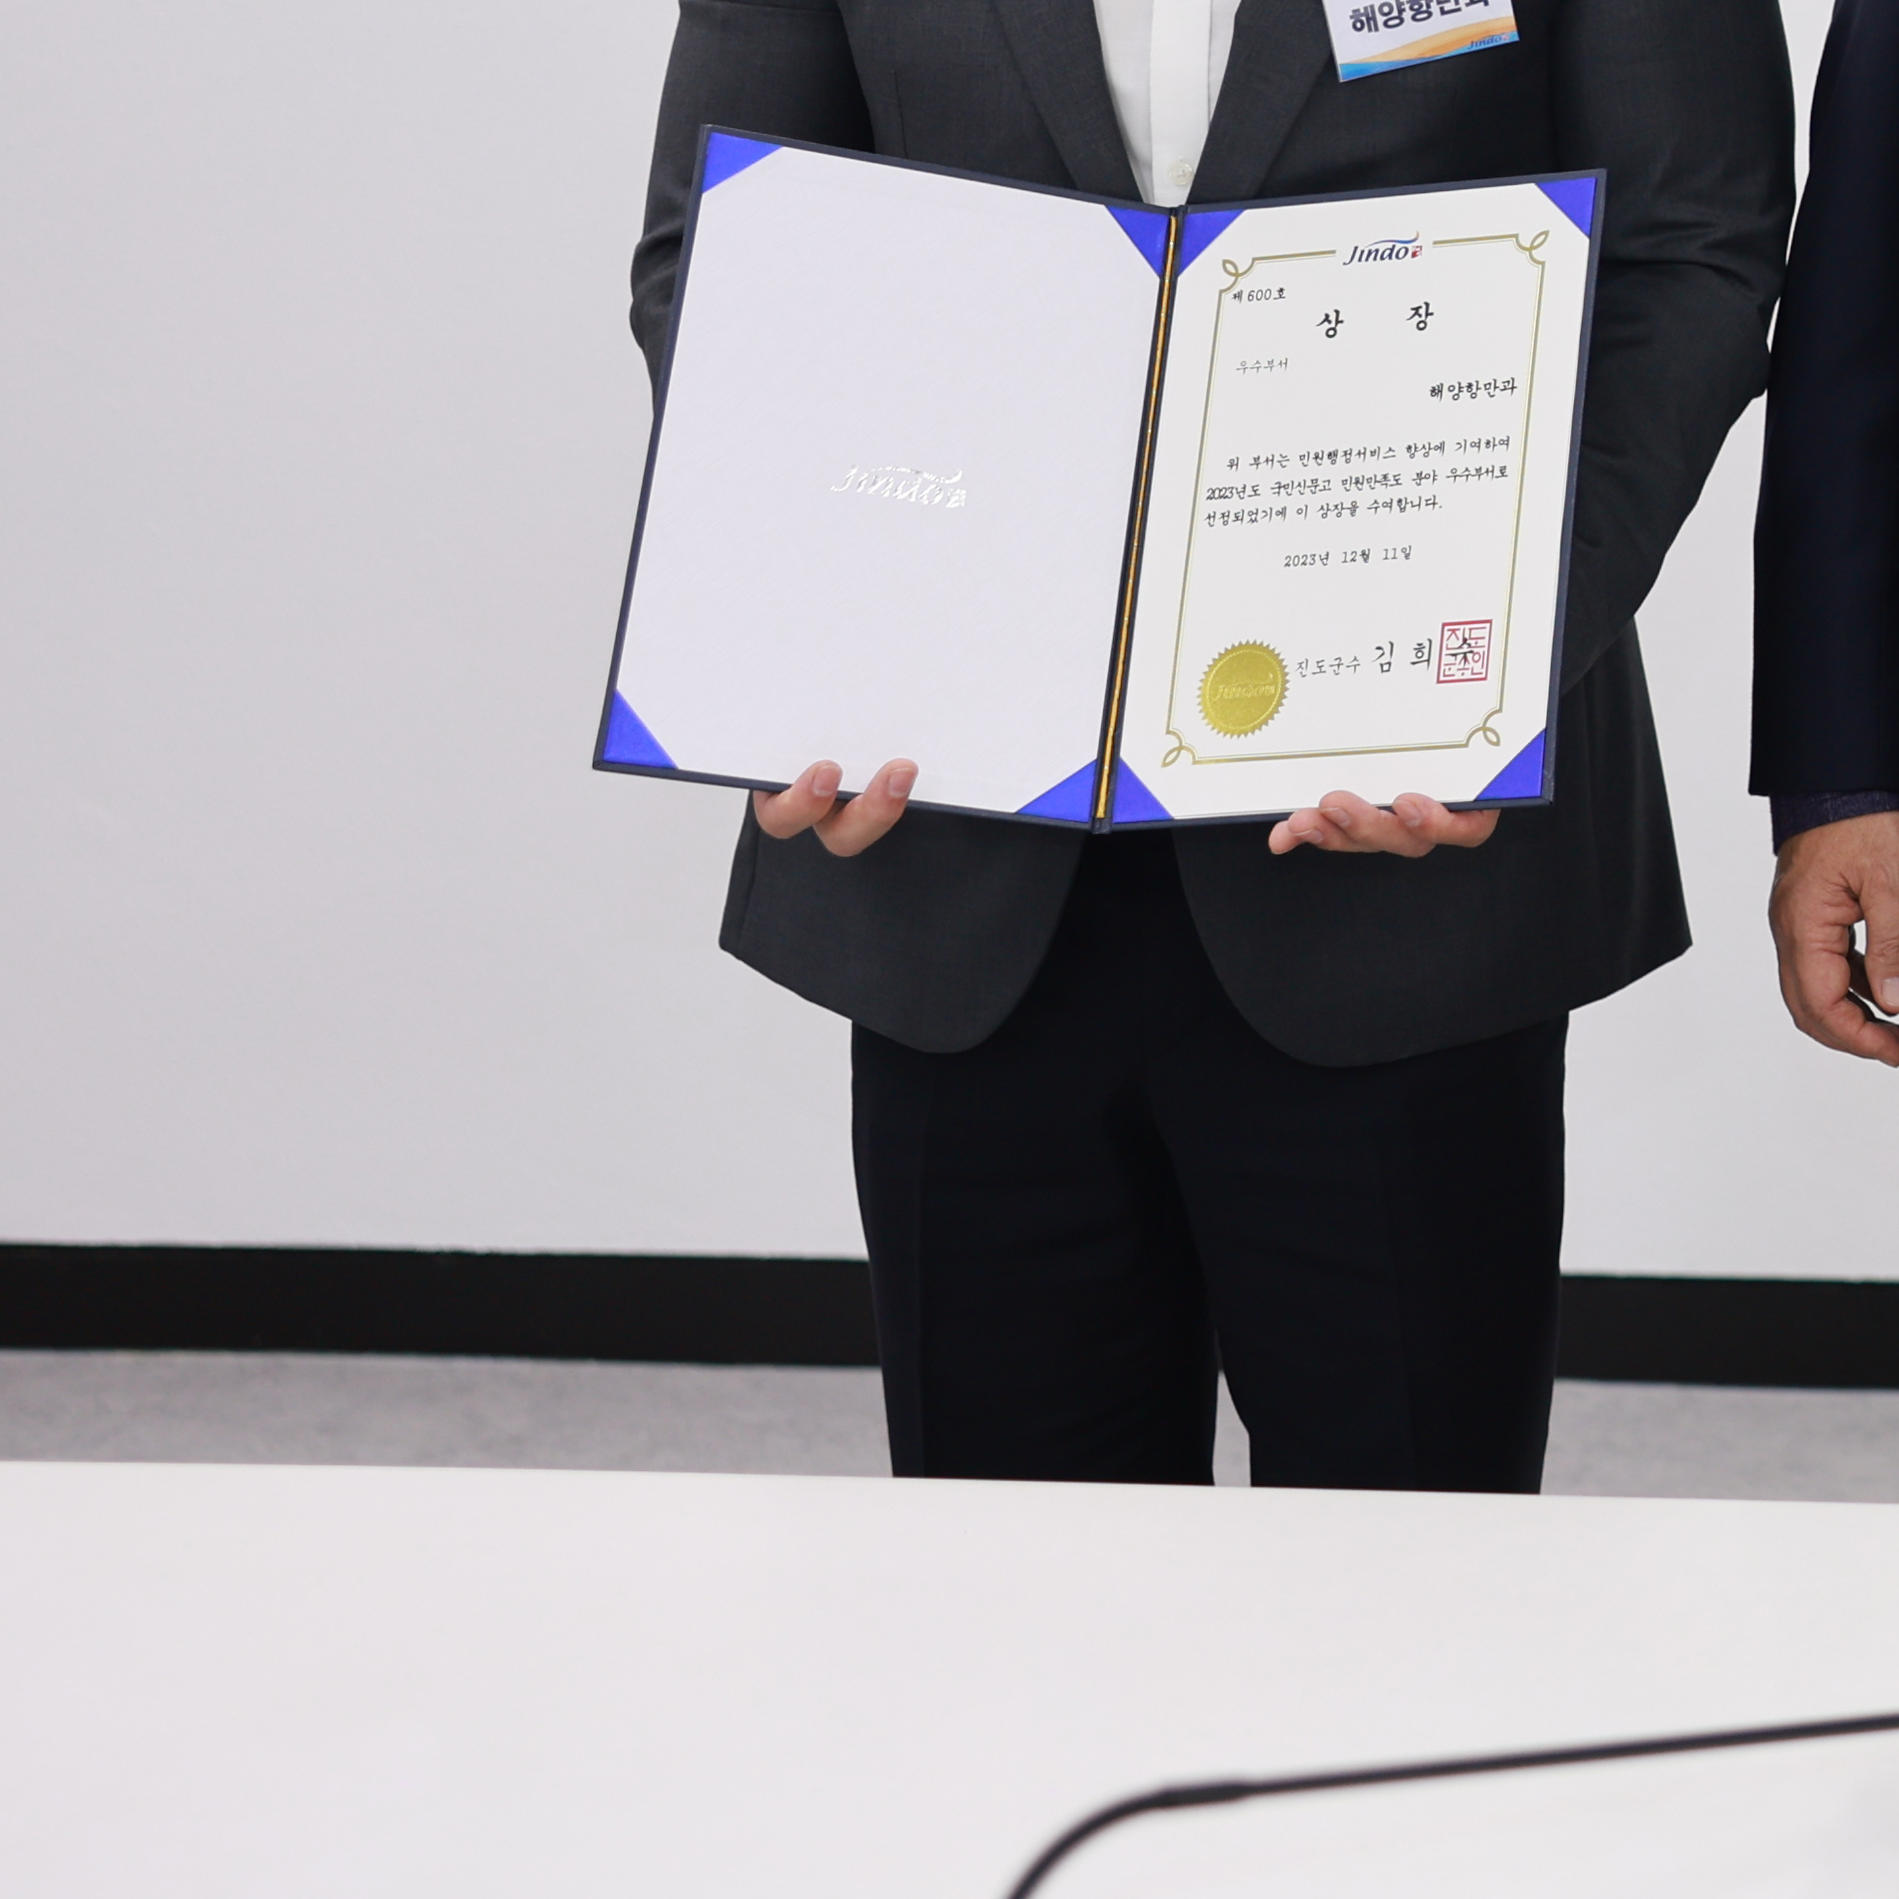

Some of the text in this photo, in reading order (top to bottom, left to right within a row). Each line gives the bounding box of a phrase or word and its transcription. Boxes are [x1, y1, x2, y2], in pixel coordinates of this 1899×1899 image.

[1342, 244, 1409, 266] Jindo
[1316, 301, 1434, 339] 상 장
[1236, 357, 1289, 375] 우수부서
[1429, 376, 1518, 400] 해양항만과
[1226, 435, 1511, 472] 위 부서는 민원행정서비스 향상에 기여하여
[1205, 464, 1509, 501] 2023년도 국민신문고 민원만족도 분야 우수부서로
[1204, 494, 1443, 528] 선정되었기에 이 상장을 수여합니다.
[1283, 545, 1413, 568] 2023년 12월 11일
[1295, 655, 1361, 678] 진도군수
